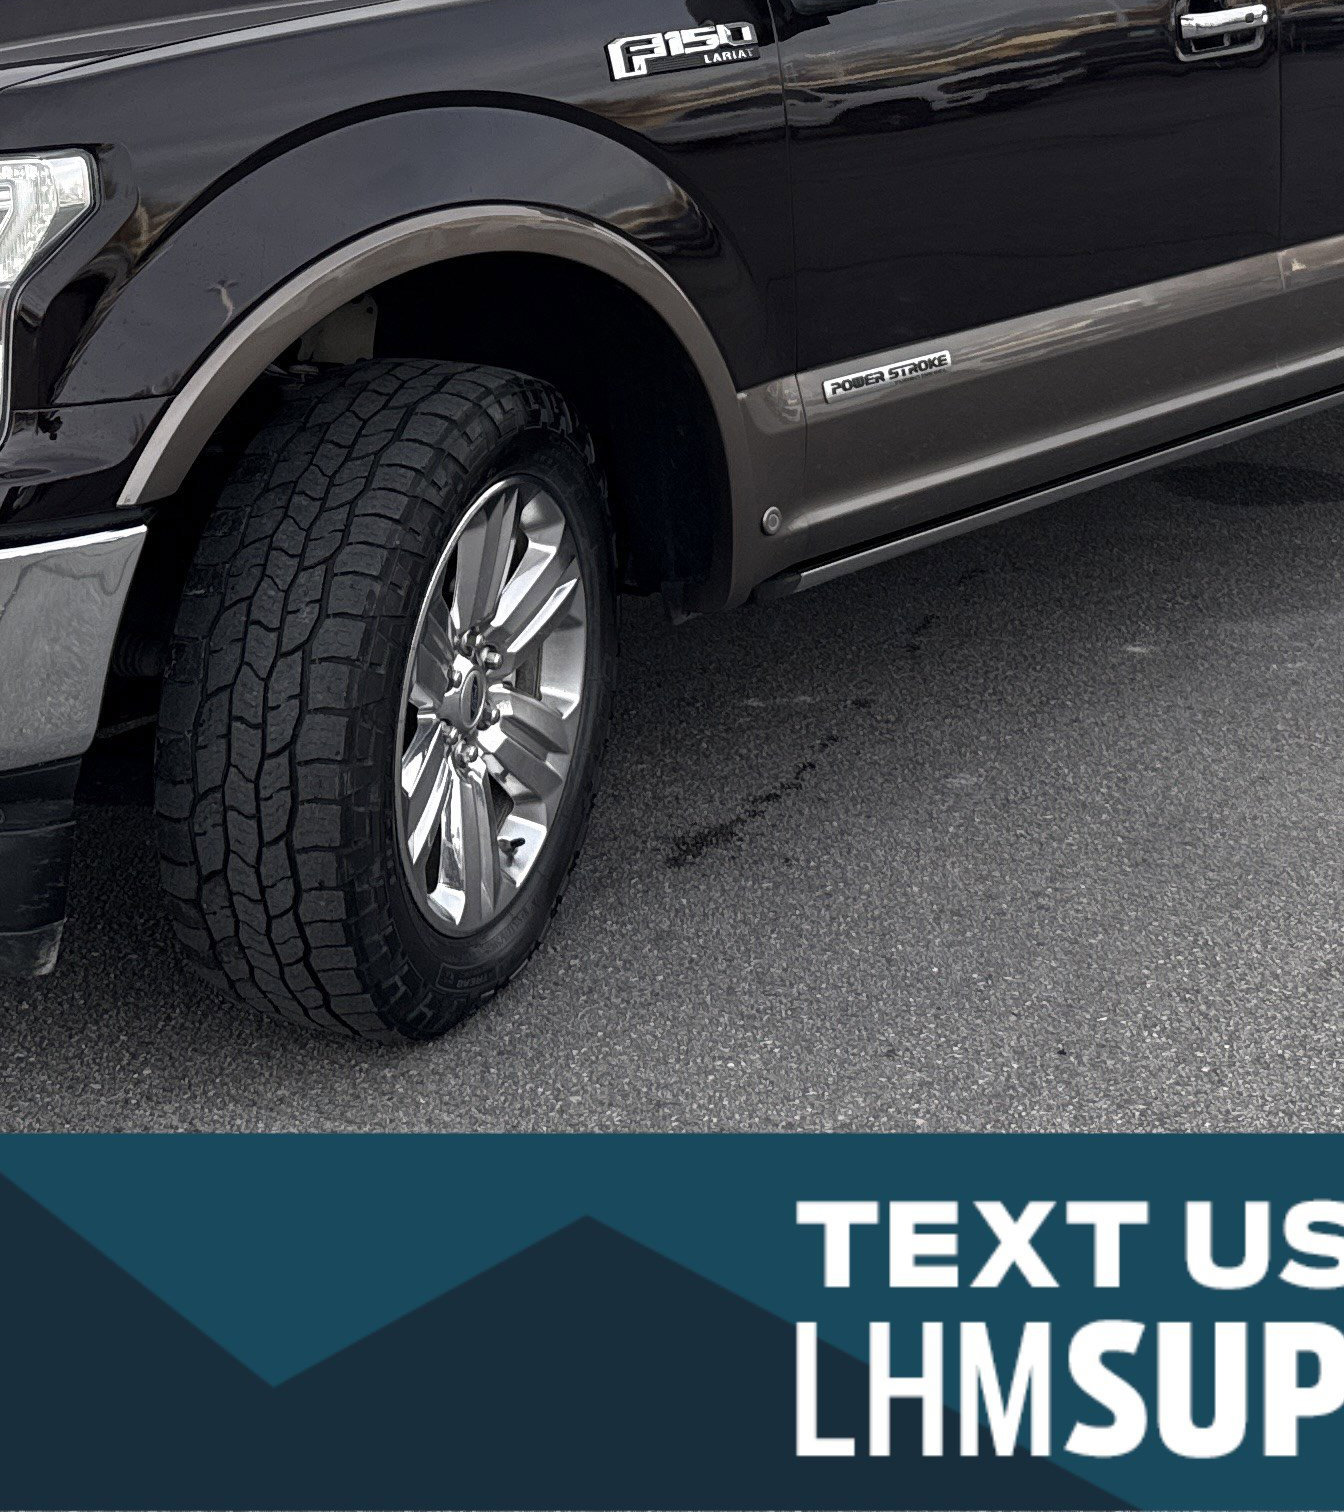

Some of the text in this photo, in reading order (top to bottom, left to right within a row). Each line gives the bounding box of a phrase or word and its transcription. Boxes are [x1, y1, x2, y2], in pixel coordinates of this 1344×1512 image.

[703, 47, 755, 65] LARIAT
[830, 370, 886, 396] POWER
[888, 353, 949, 381] STROKE
